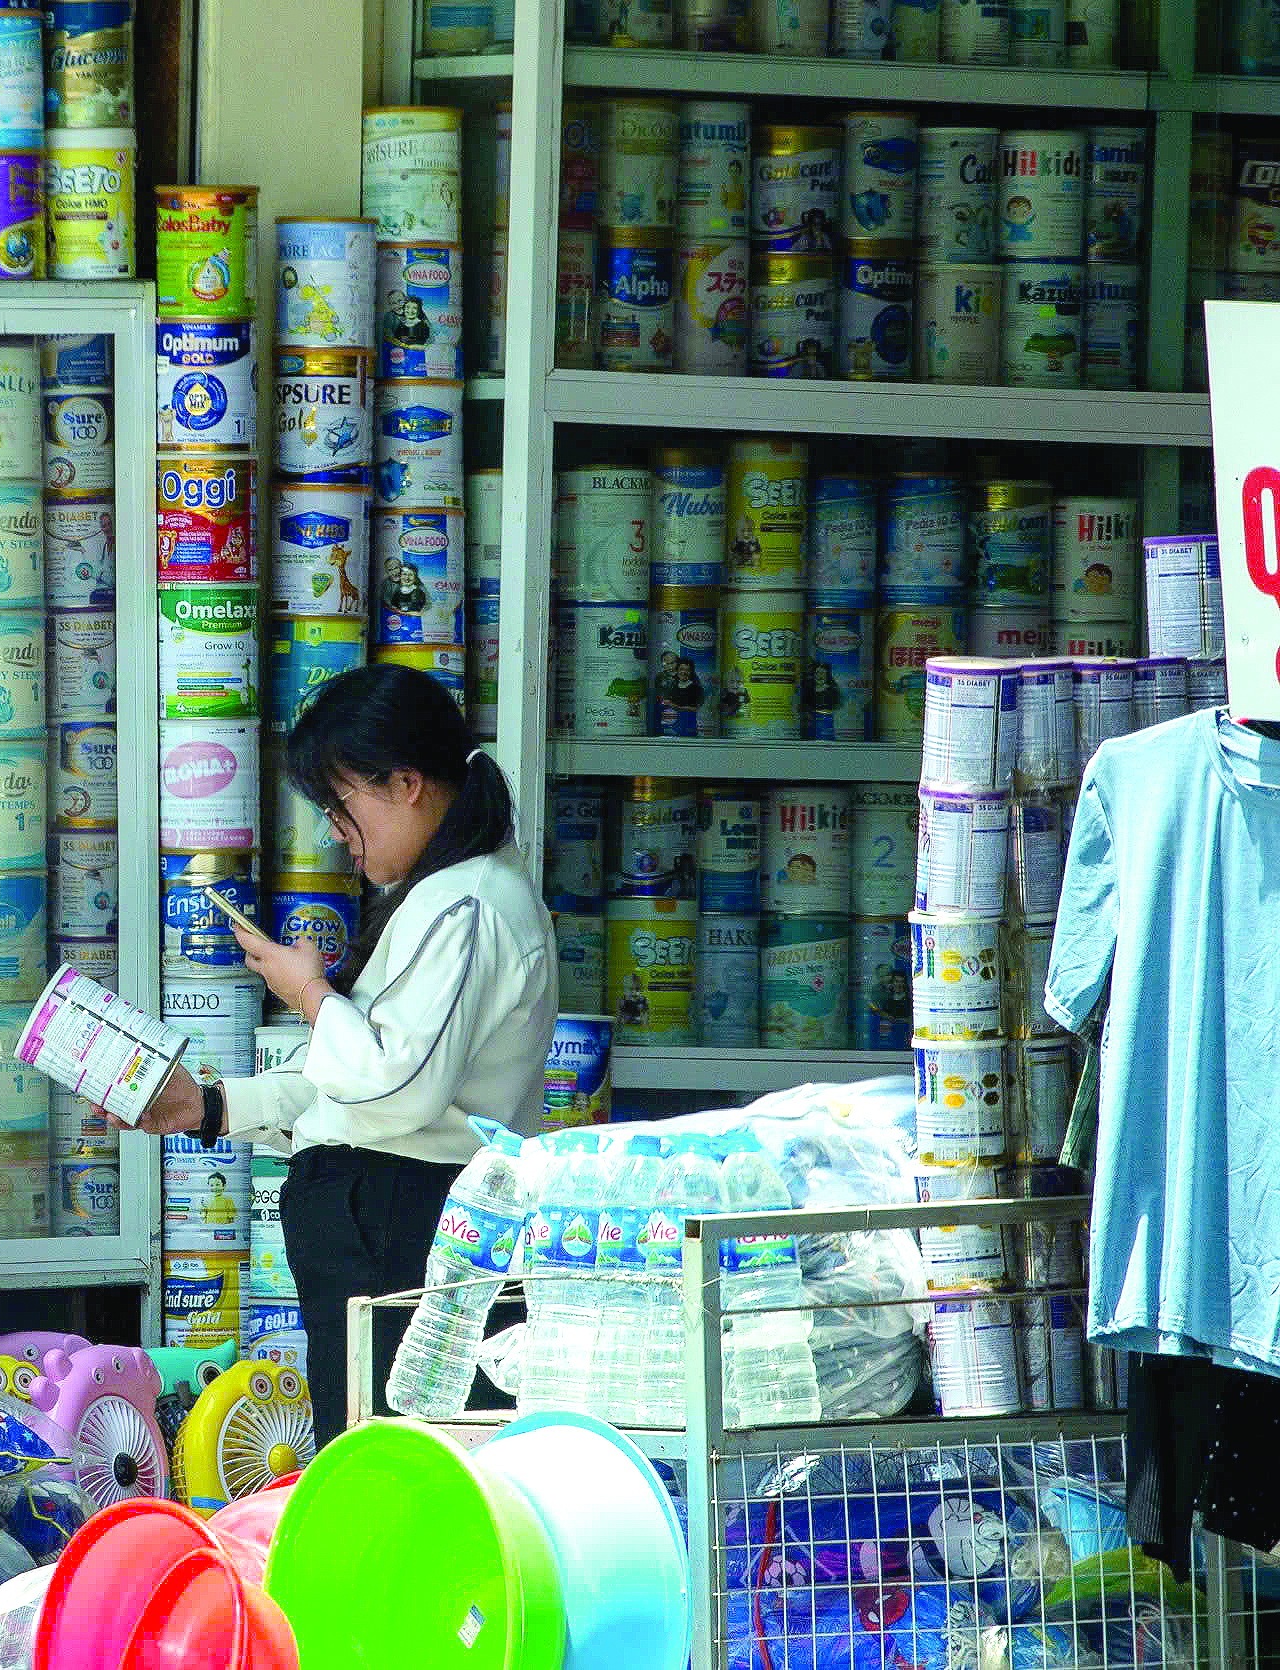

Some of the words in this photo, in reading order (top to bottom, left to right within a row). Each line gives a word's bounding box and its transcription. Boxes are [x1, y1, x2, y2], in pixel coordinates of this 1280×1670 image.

[162, 332, 240, 355] Optimum
[161, 467, 238, 508] Oggi
[204, 641, 232, 652] Grow
[872, 835, 897, 868] 2
[286, 915, 340, 932] Grow
[265, 1311, 298, 1331] GOLD
